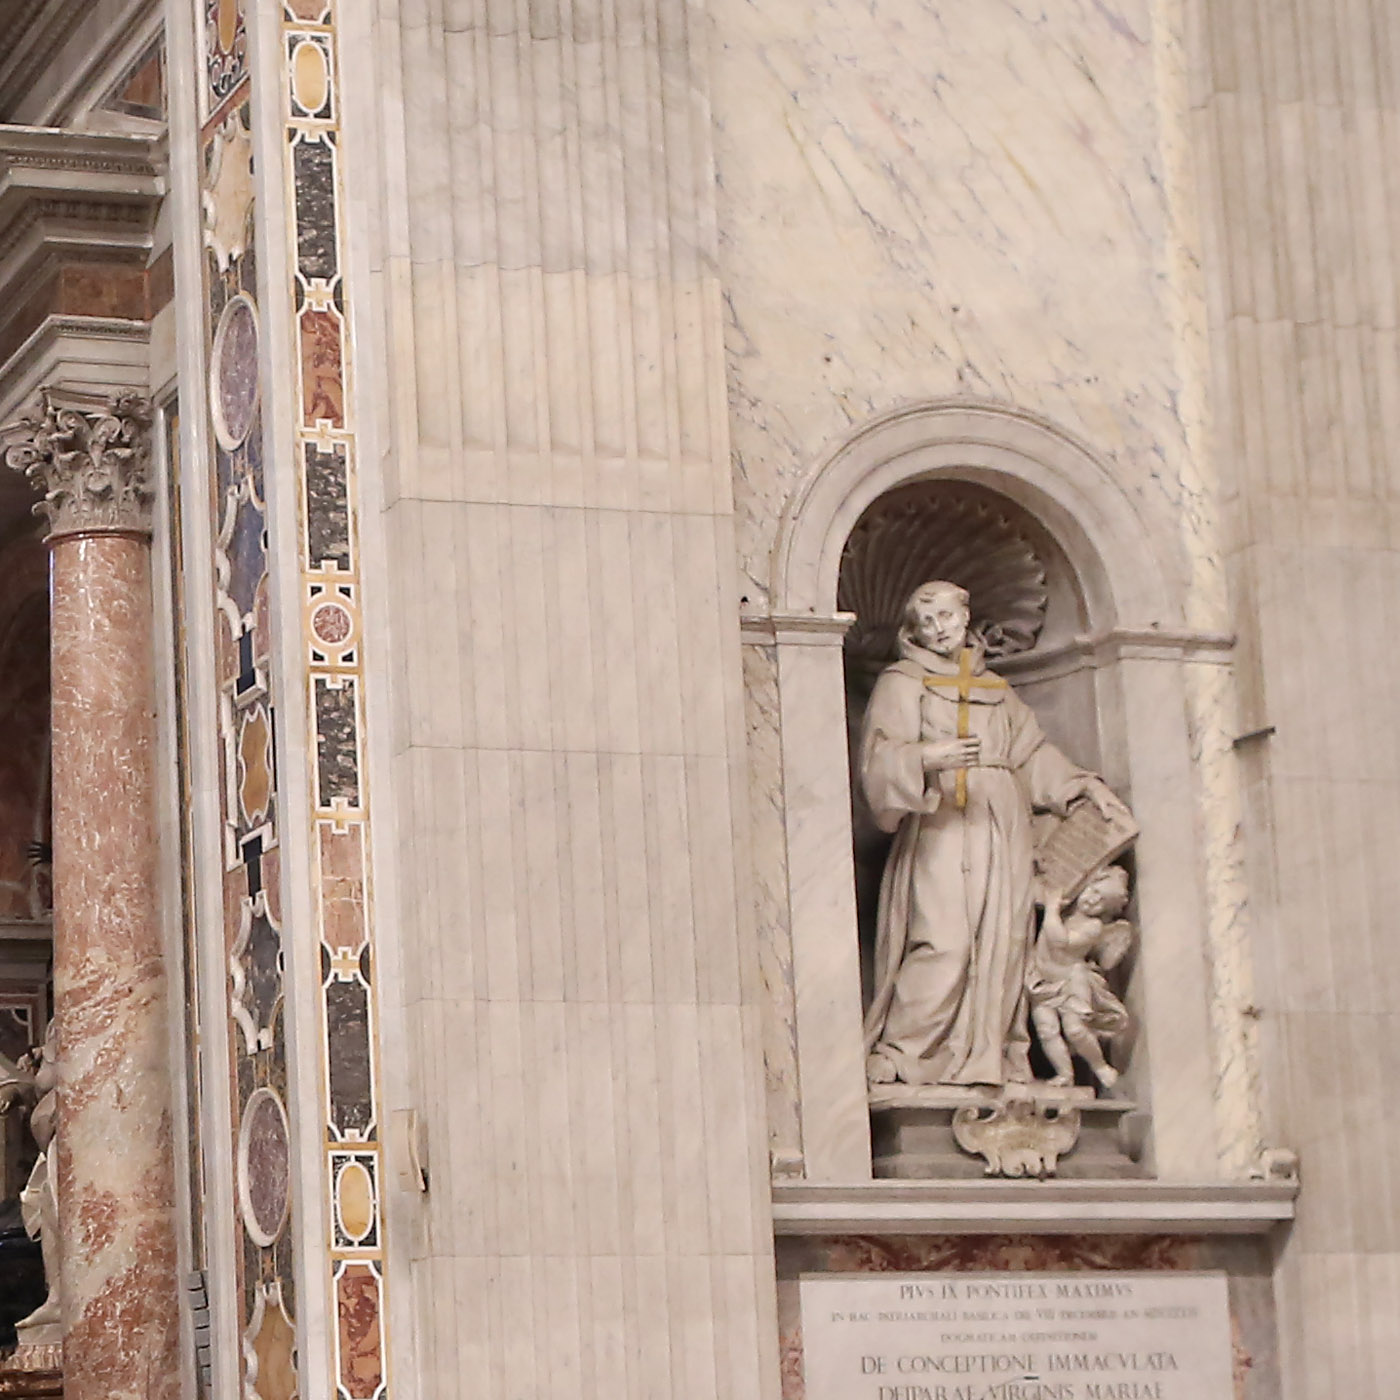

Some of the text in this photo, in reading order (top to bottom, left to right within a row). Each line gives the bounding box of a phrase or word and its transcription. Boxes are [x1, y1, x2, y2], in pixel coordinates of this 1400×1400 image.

[900, 1283, 1133, 1299] PIVS IX PONTIFEX MAXIMVS
[861, 1352, 1179, 1374] DE CONCEPTIONE IMMACVLATA
[1086, 1381, 1165, 1400] MARIAE
